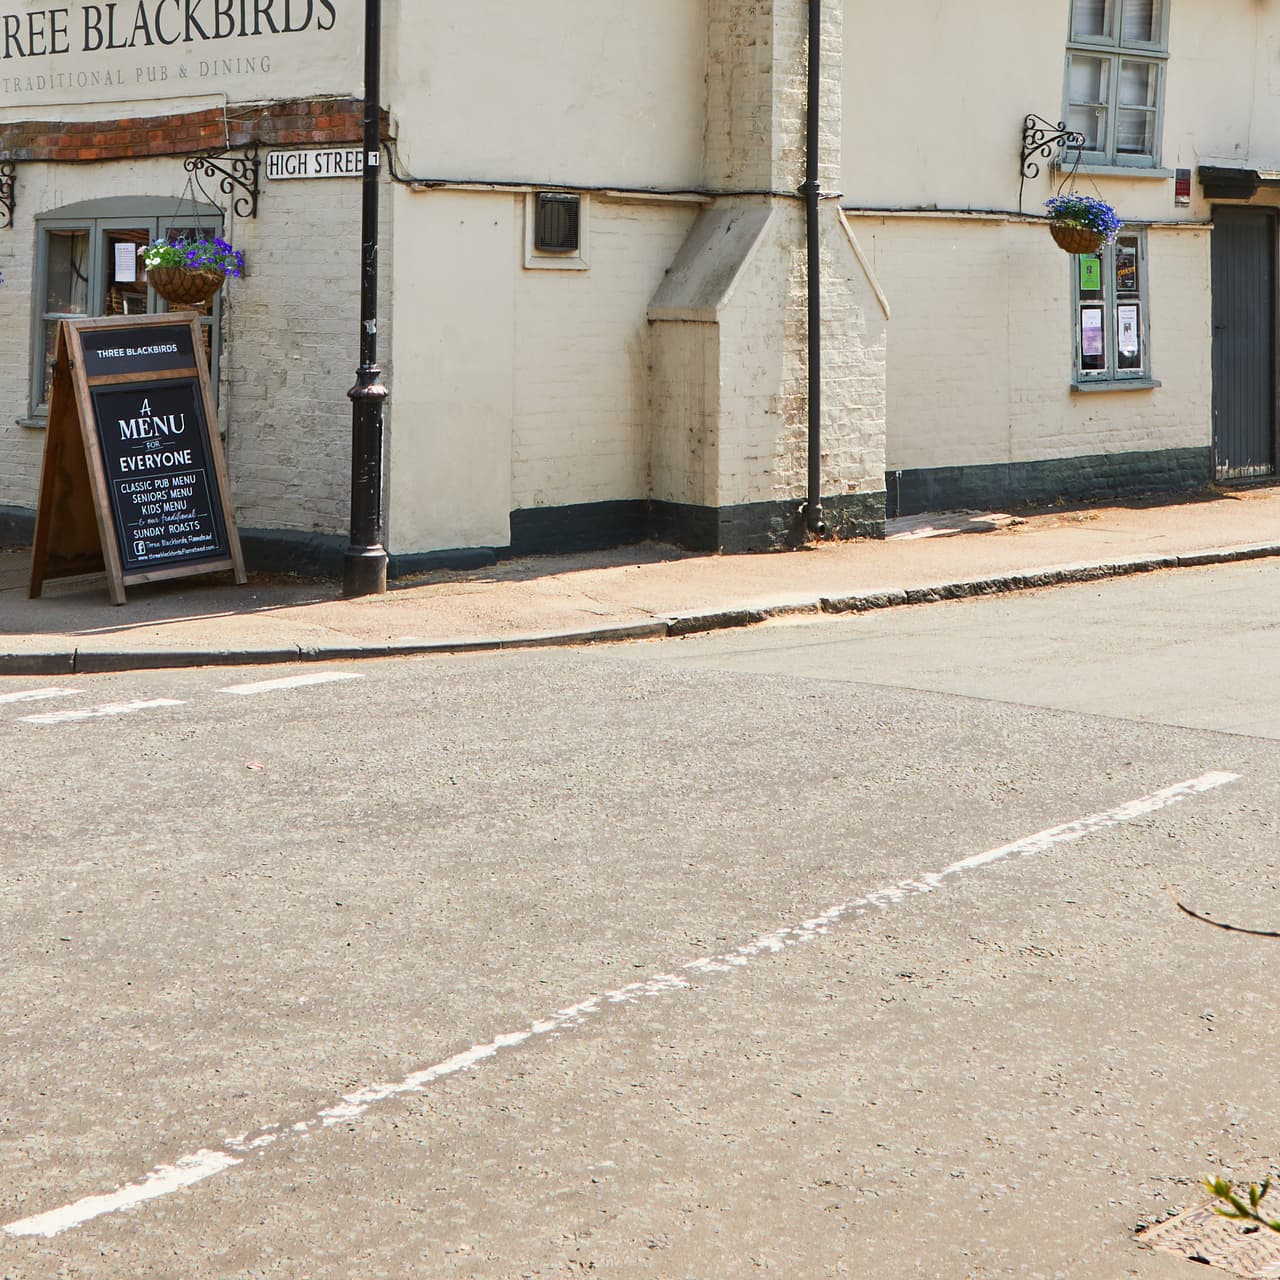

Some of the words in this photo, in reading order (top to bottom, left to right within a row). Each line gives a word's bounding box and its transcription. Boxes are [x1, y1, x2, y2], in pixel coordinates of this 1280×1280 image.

[2, 70, 125, 93] TRADITIONAL
[136, 66, 168, 83] PUB
[178, 64, 187, 79] &
[199, 55, 270, 77] DINING
[270, 154, 307, 175] HIGH
[314, 151, 363, 173] STREE
[97, 348, 125, 358] THREE
[126, 344, 177, 356] BLACKBIRDS
[140, 398, 151, 416] A
[119, 414, 185, 440] MENU
[146, 440, 160, 449] FOR
[120, 450, 192, 472] EVERYONE
[121, 481, 152, 493] CLASSIC
[154, 478, 169, 489] PUB
[172, 475, 196, 487] MENU
[170, 487, 193, 498] MENU
[163, 500, 187, 512] MENU
[133, 526, 165, 539] SUNDAY
[168, 521, 200, 534] ROASTS
